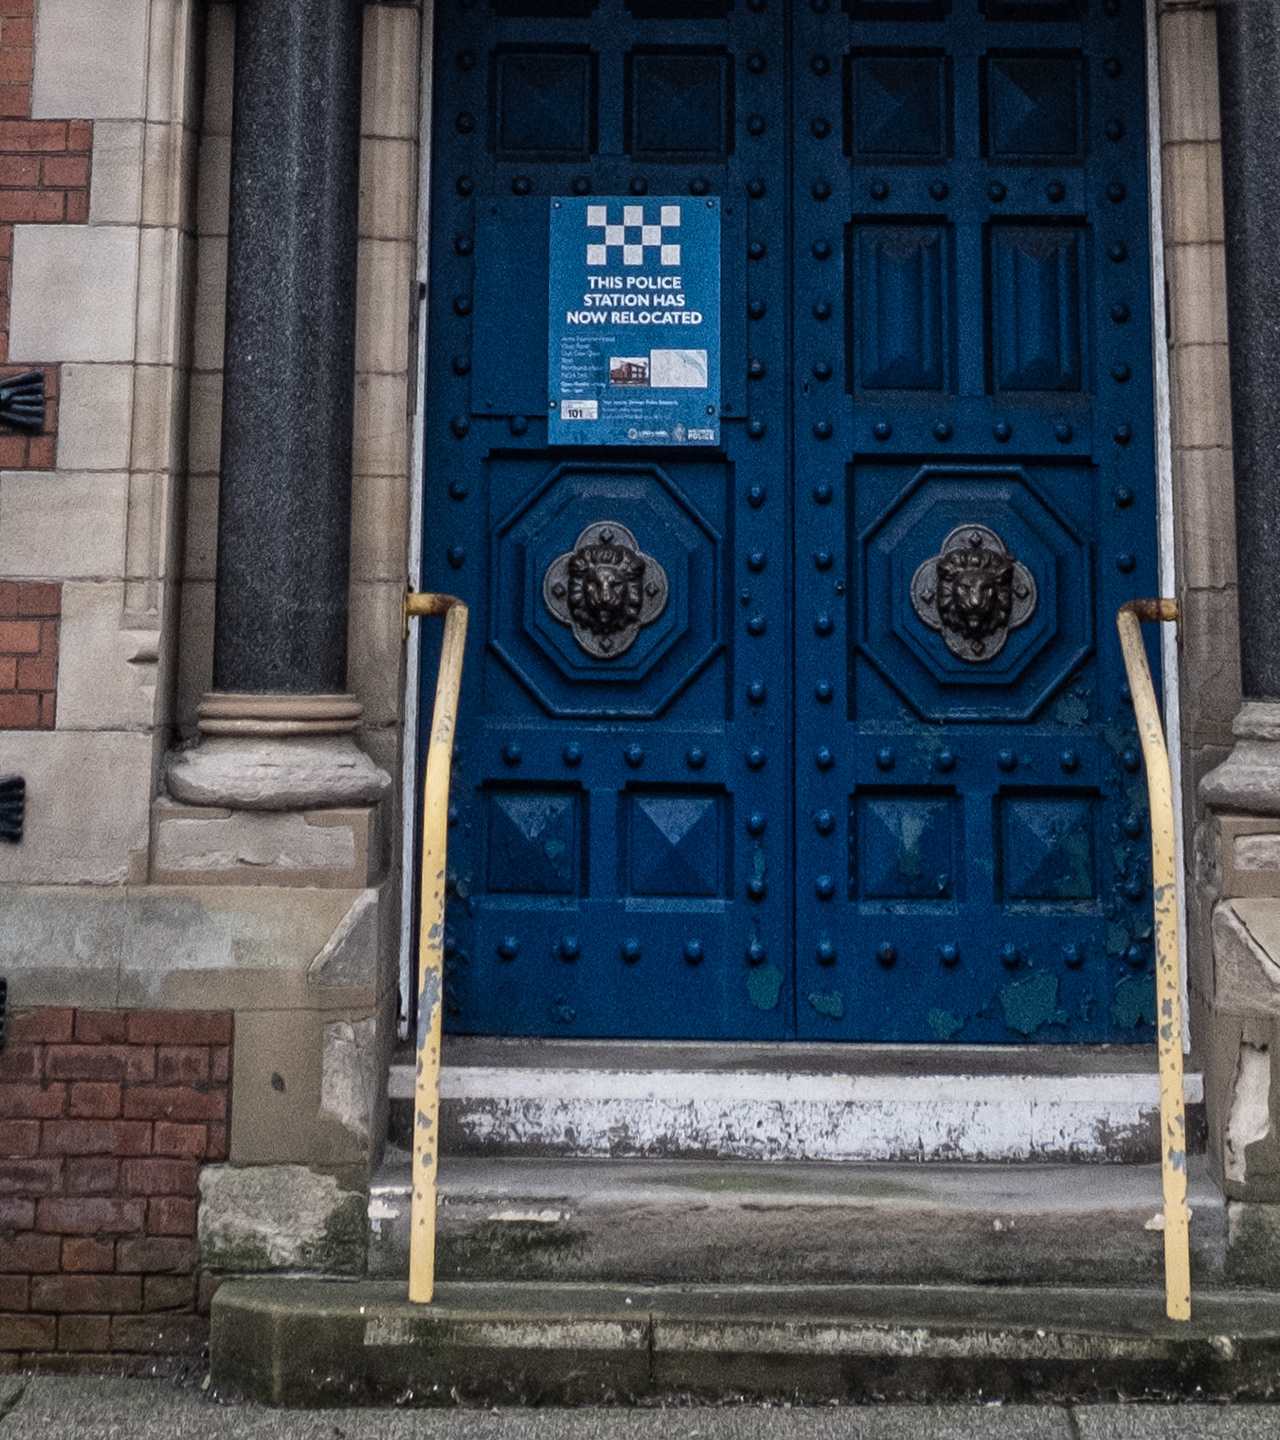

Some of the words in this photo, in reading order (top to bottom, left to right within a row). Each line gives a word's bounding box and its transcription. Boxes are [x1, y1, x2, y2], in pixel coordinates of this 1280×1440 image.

[587, 276, 623, 289] THIS
[626, 276, 682, 289] POLICE
[583, 293, 650, 307] STATION
[653, 293, 686, 307] HAS
[566, 311, 608, 325] NOW
[611, 311, 703, 325] RELOCATED
[568, 409, 583, 418] 101
